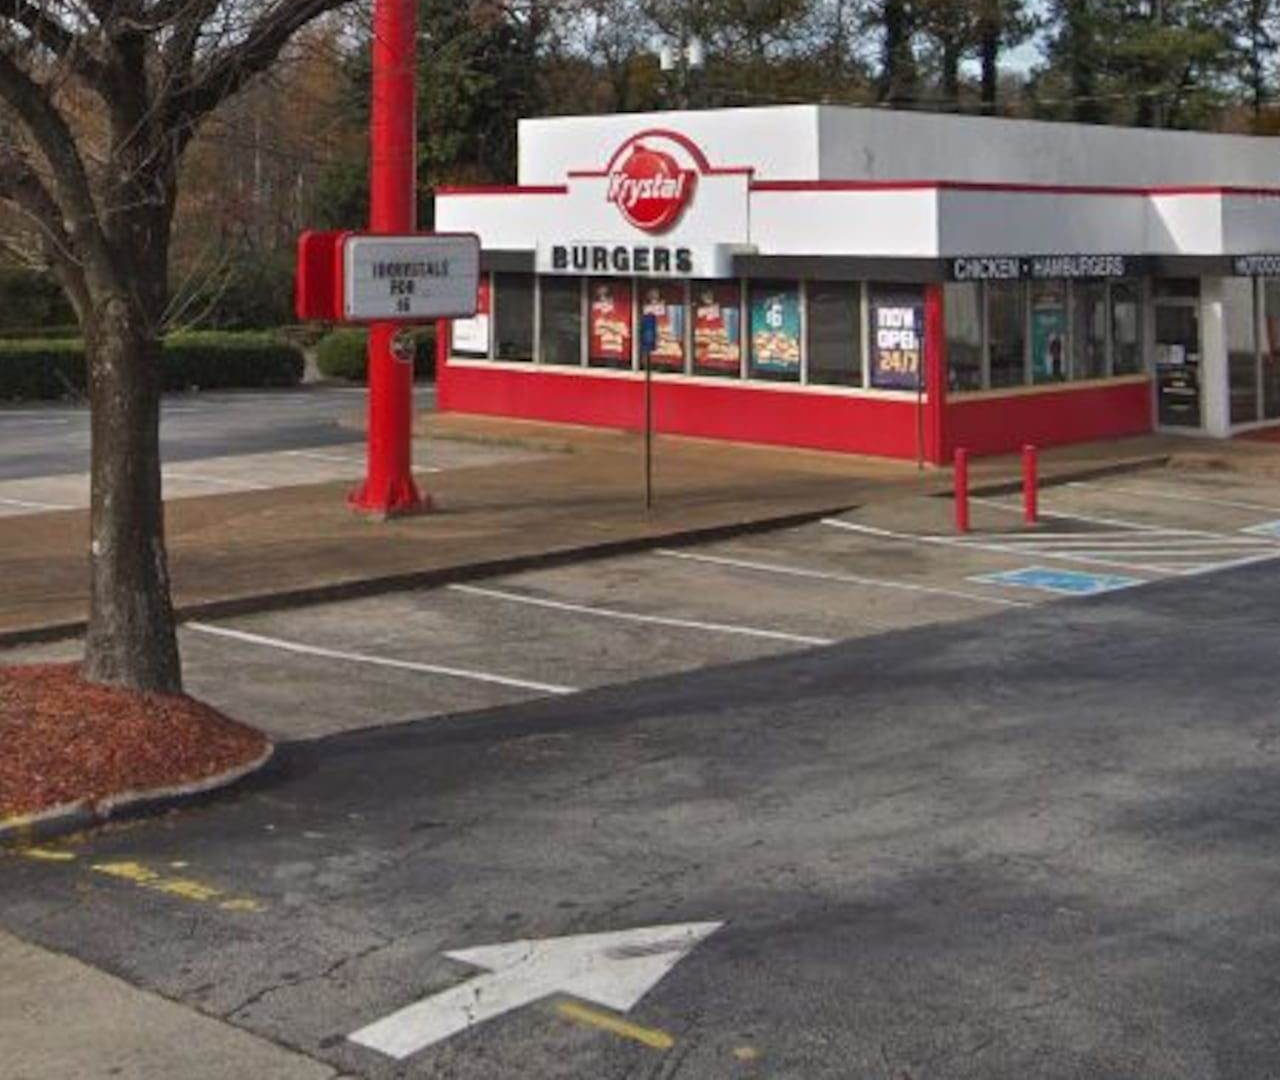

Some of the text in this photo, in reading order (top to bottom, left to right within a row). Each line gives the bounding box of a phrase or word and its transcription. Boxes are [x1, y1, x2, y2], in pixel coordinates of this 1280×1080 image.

[608, 171, 686, 207] Krystal
[552, 245, 694, 272] BURGERS
[953, 255, 1126, 280] CHICKEN HAMBURGERS
[879, 350, 919, 373] 24/7
